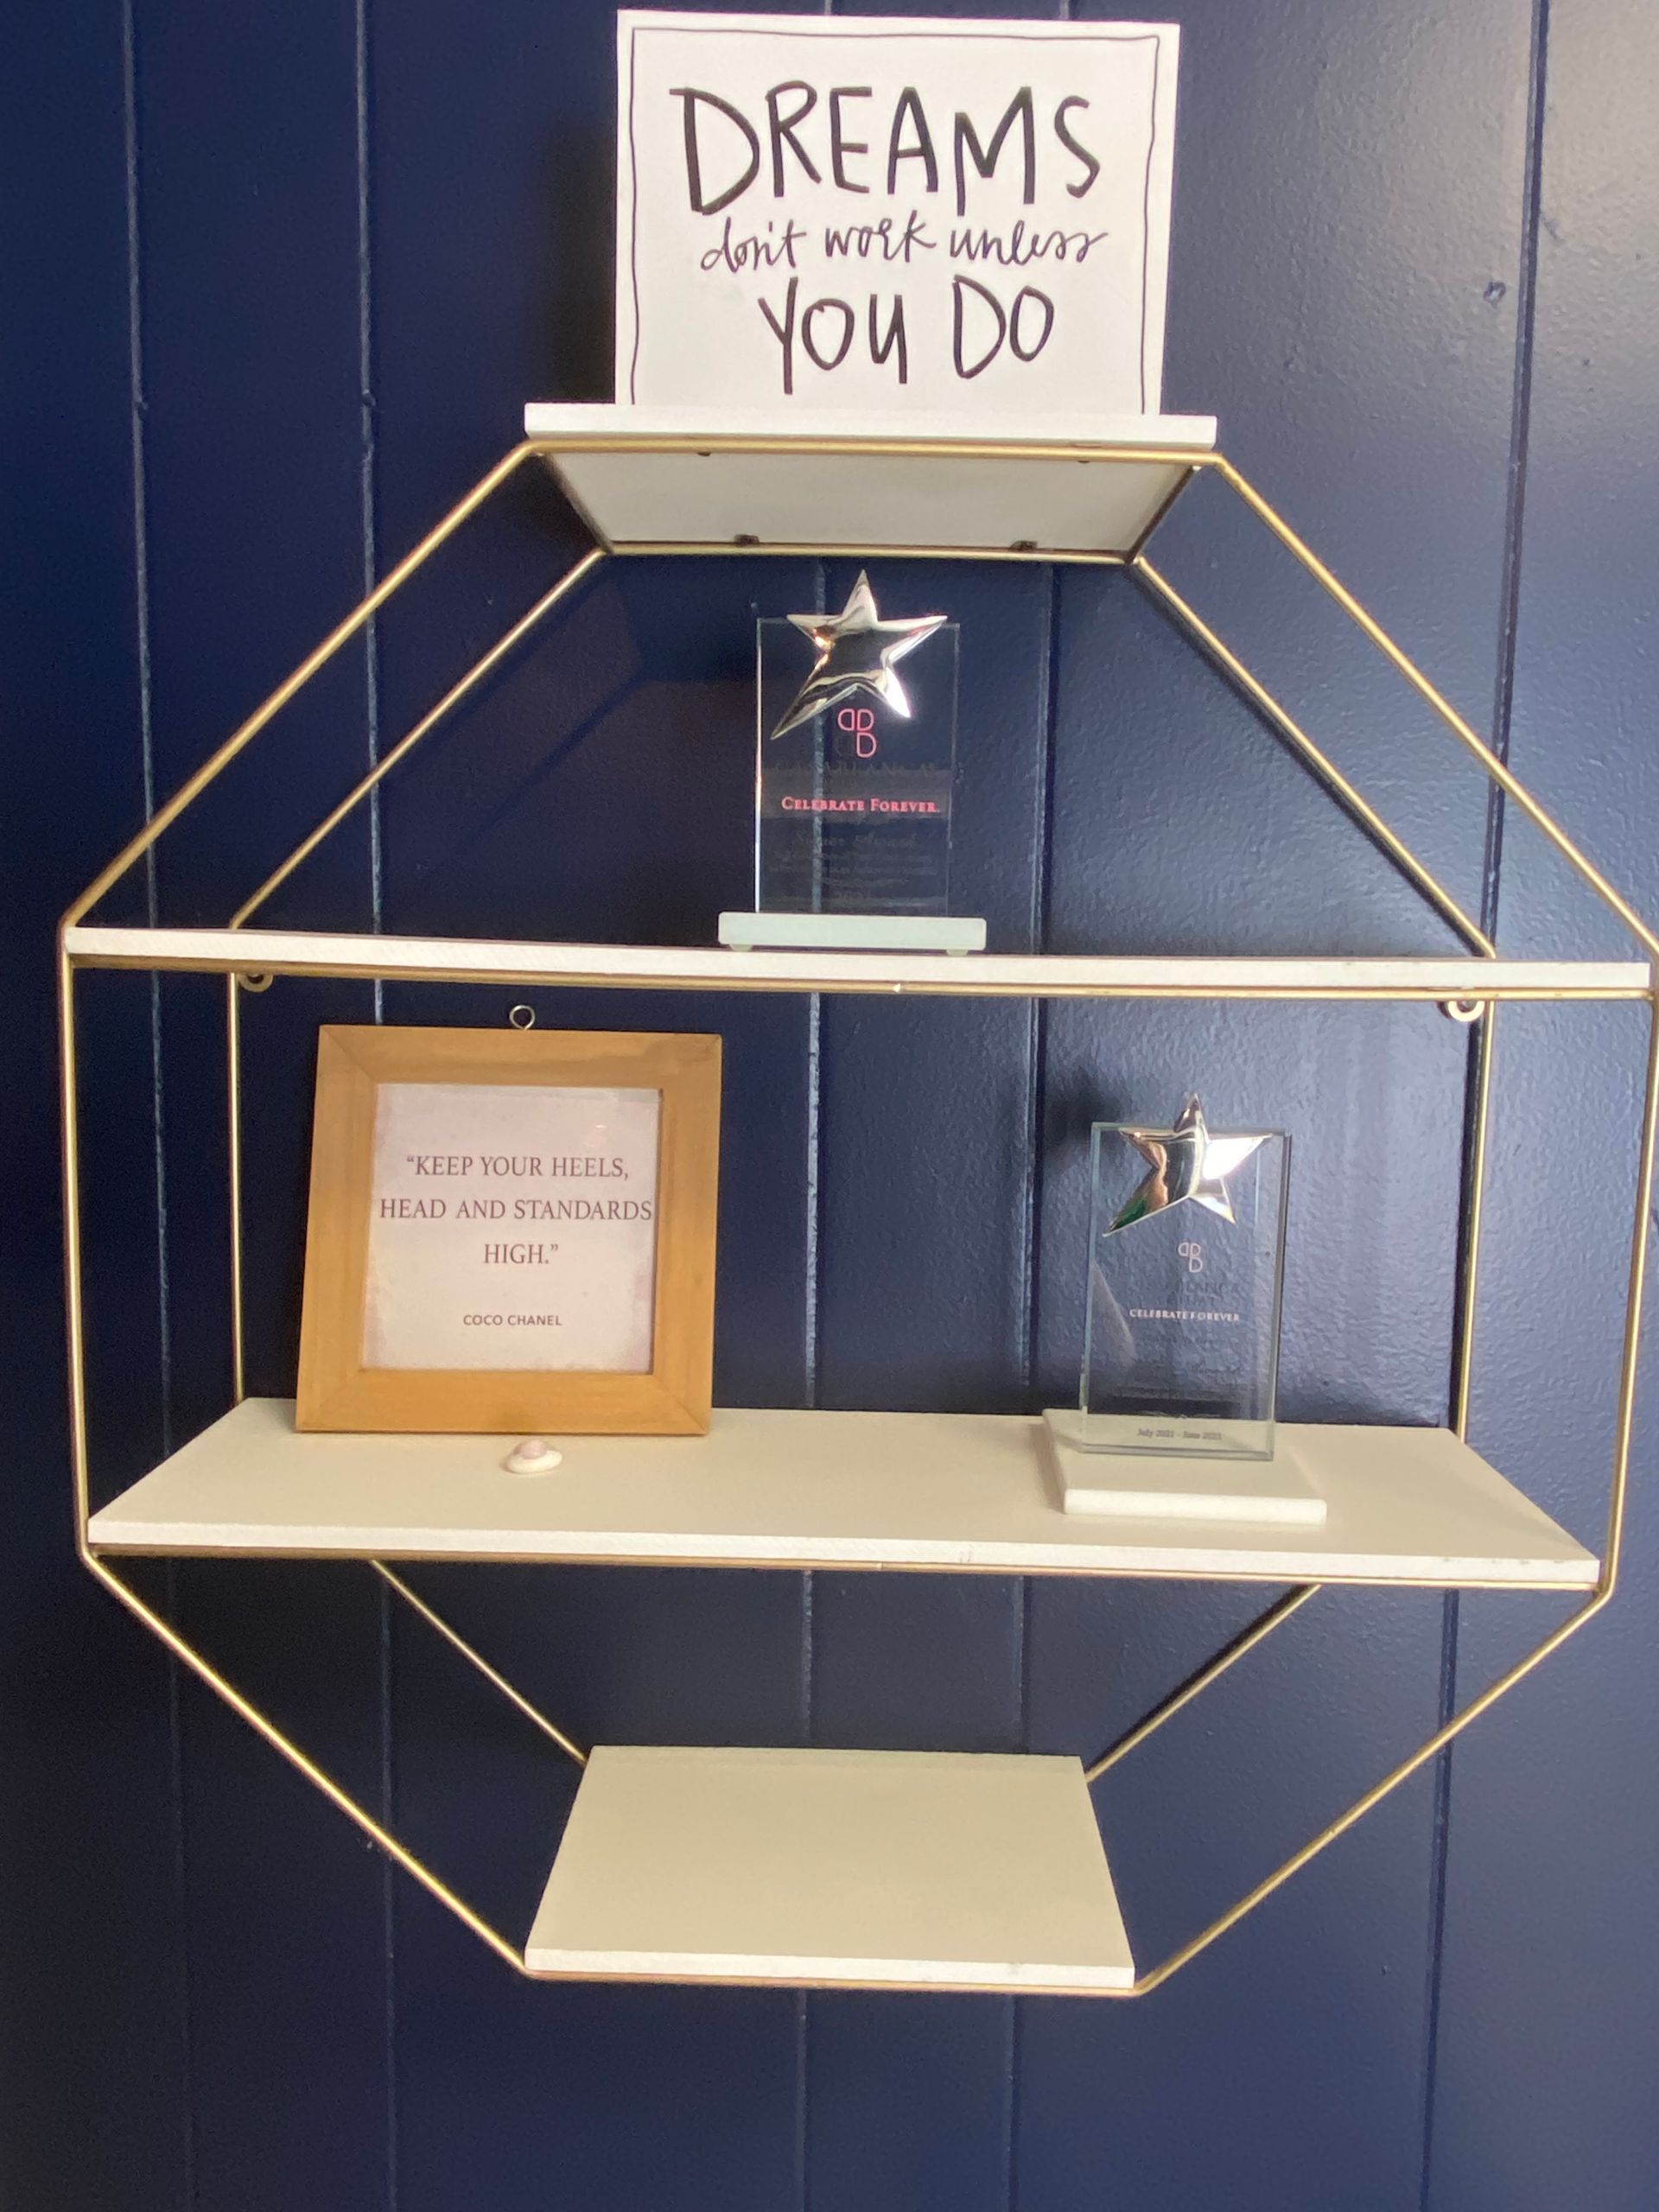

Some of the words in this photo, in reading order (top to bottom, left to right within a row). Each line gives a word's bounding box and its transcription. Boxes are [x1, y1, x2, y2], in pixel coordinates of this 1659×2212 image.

[669, 80, 1100, 216] DREAMS
[700, 216, 806, 272] don't
[824, 210, 936, 262] work
[950, 220, 1108, 264] unless
[758, 276, 907, 394] YOU
[953, 275, 1053, 378] DO
[480, 1156, 542, 1177] YOUR
[551, 1158, 628, 1180] HEELS,
[380, 1198, 446, 1218] HEAD
[455, 1200, 505, 1219] AND
[513, 1199, 652, 1220] STANDARDS
[463, 1314, 503, 1326] COCO
[507, 1315, 563, 1326] CHANEL
